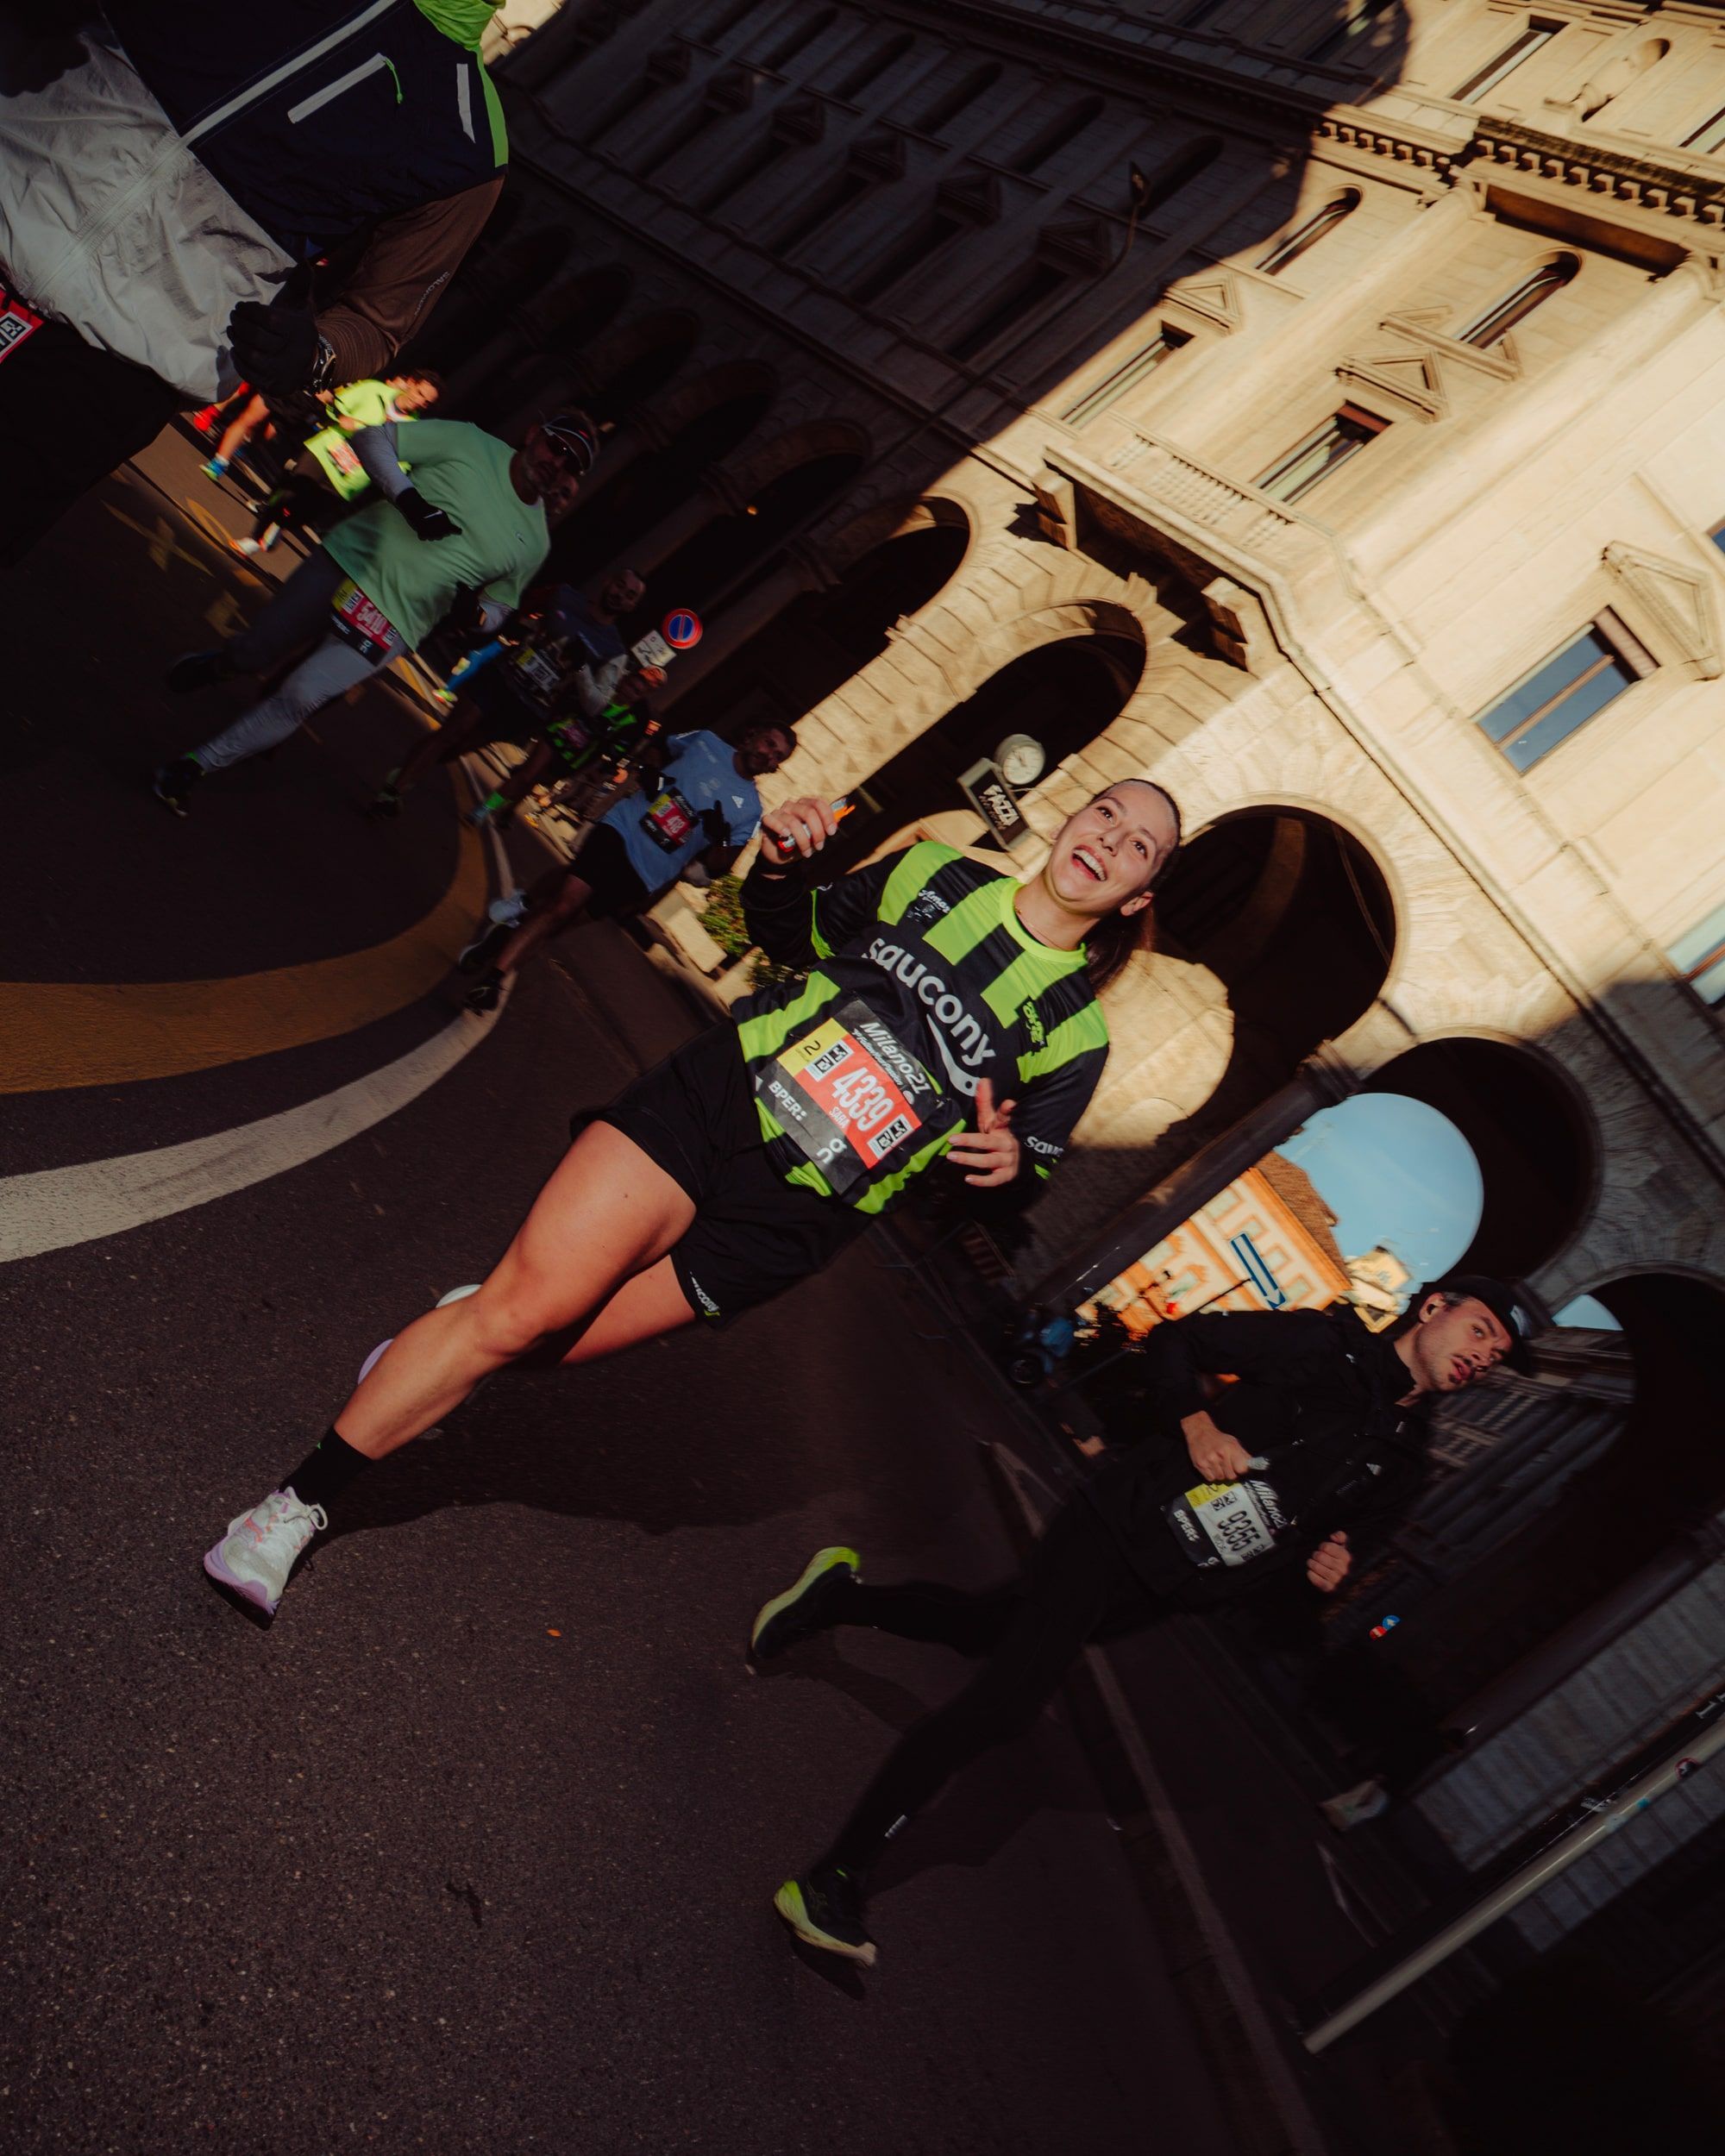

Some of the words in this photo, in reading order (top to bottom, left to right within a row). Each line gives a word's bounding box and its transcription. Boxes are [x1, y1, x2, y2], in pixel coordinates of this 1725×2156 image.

[861, 937, 997, 1067] saucony
[803, 1040, 822, 1056] 2
[859, 1021, 932, 1095] Milano21
[831, 1067, 894, 1132] 4339
[1217, 1509, 1261, 1551] 9355
